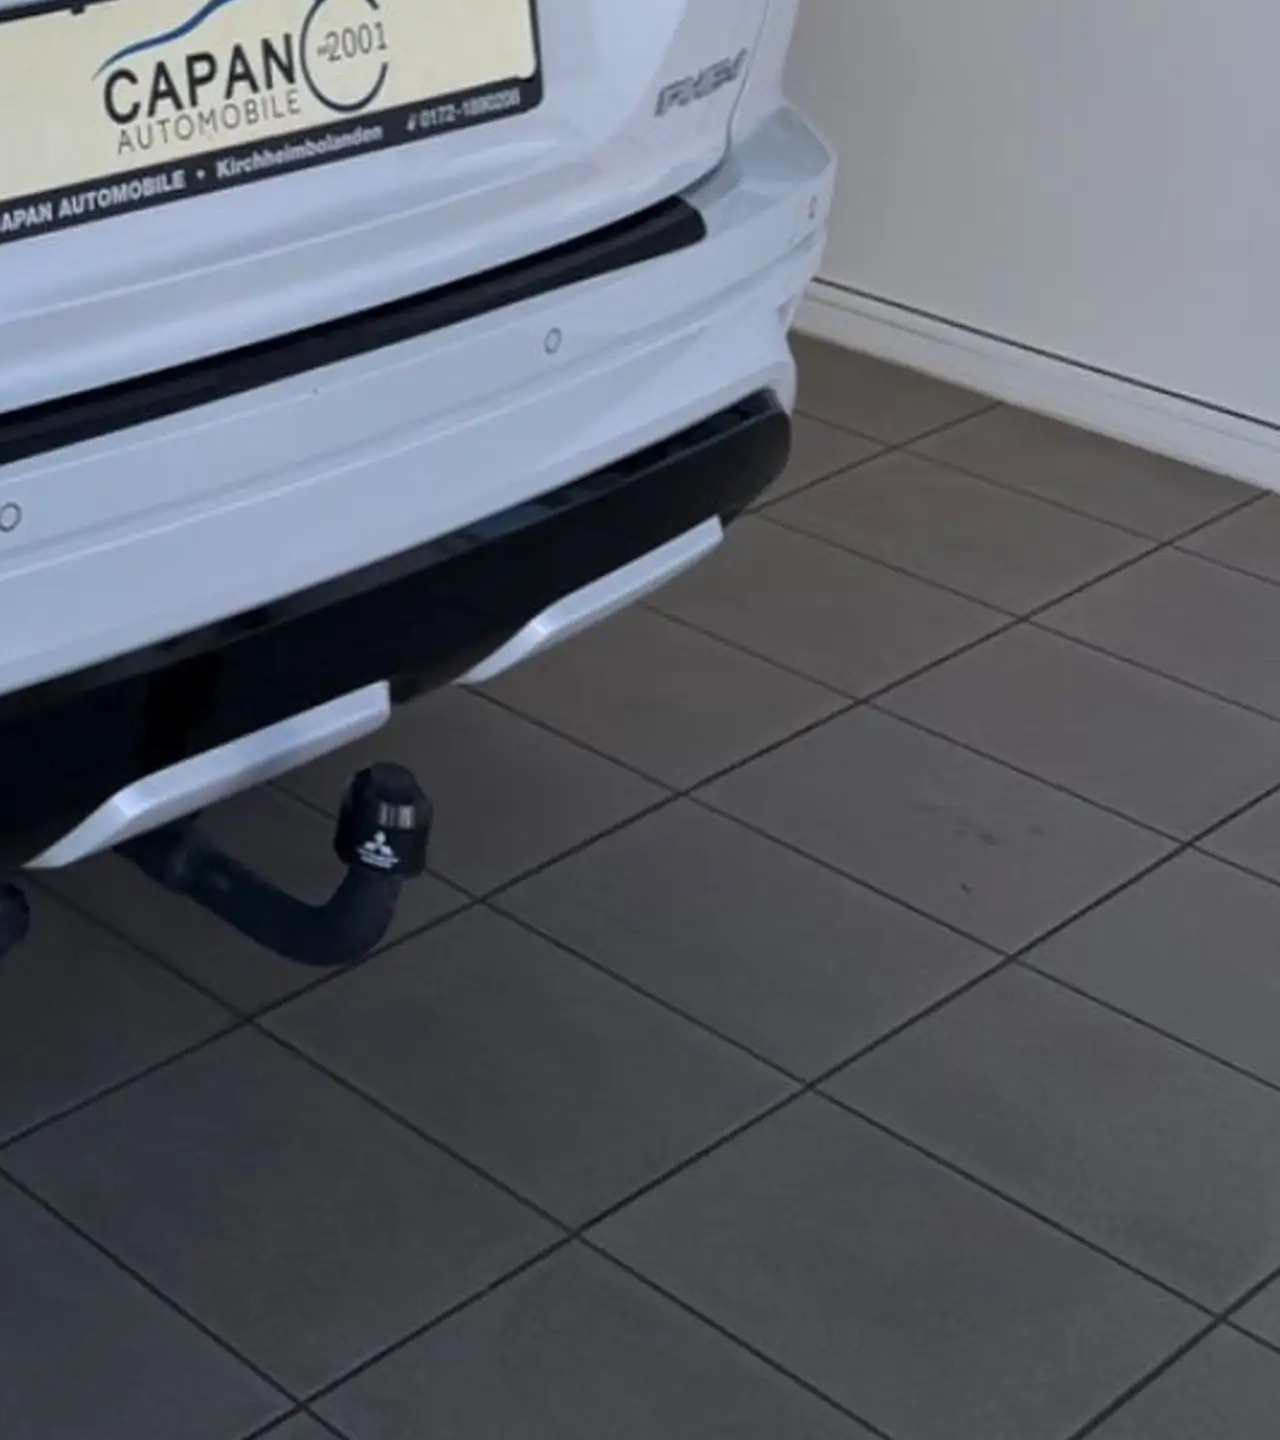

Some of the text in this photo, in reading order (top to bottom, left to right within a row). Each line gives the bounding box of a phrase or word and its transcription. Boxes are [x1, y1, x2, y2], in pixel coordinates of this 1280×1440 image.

[103, 32, 297, 125] CAPAN
[117, 88, 302, 156] AUTOMOBILE
[58, 169, 187, 218] AUTOMOBILE
